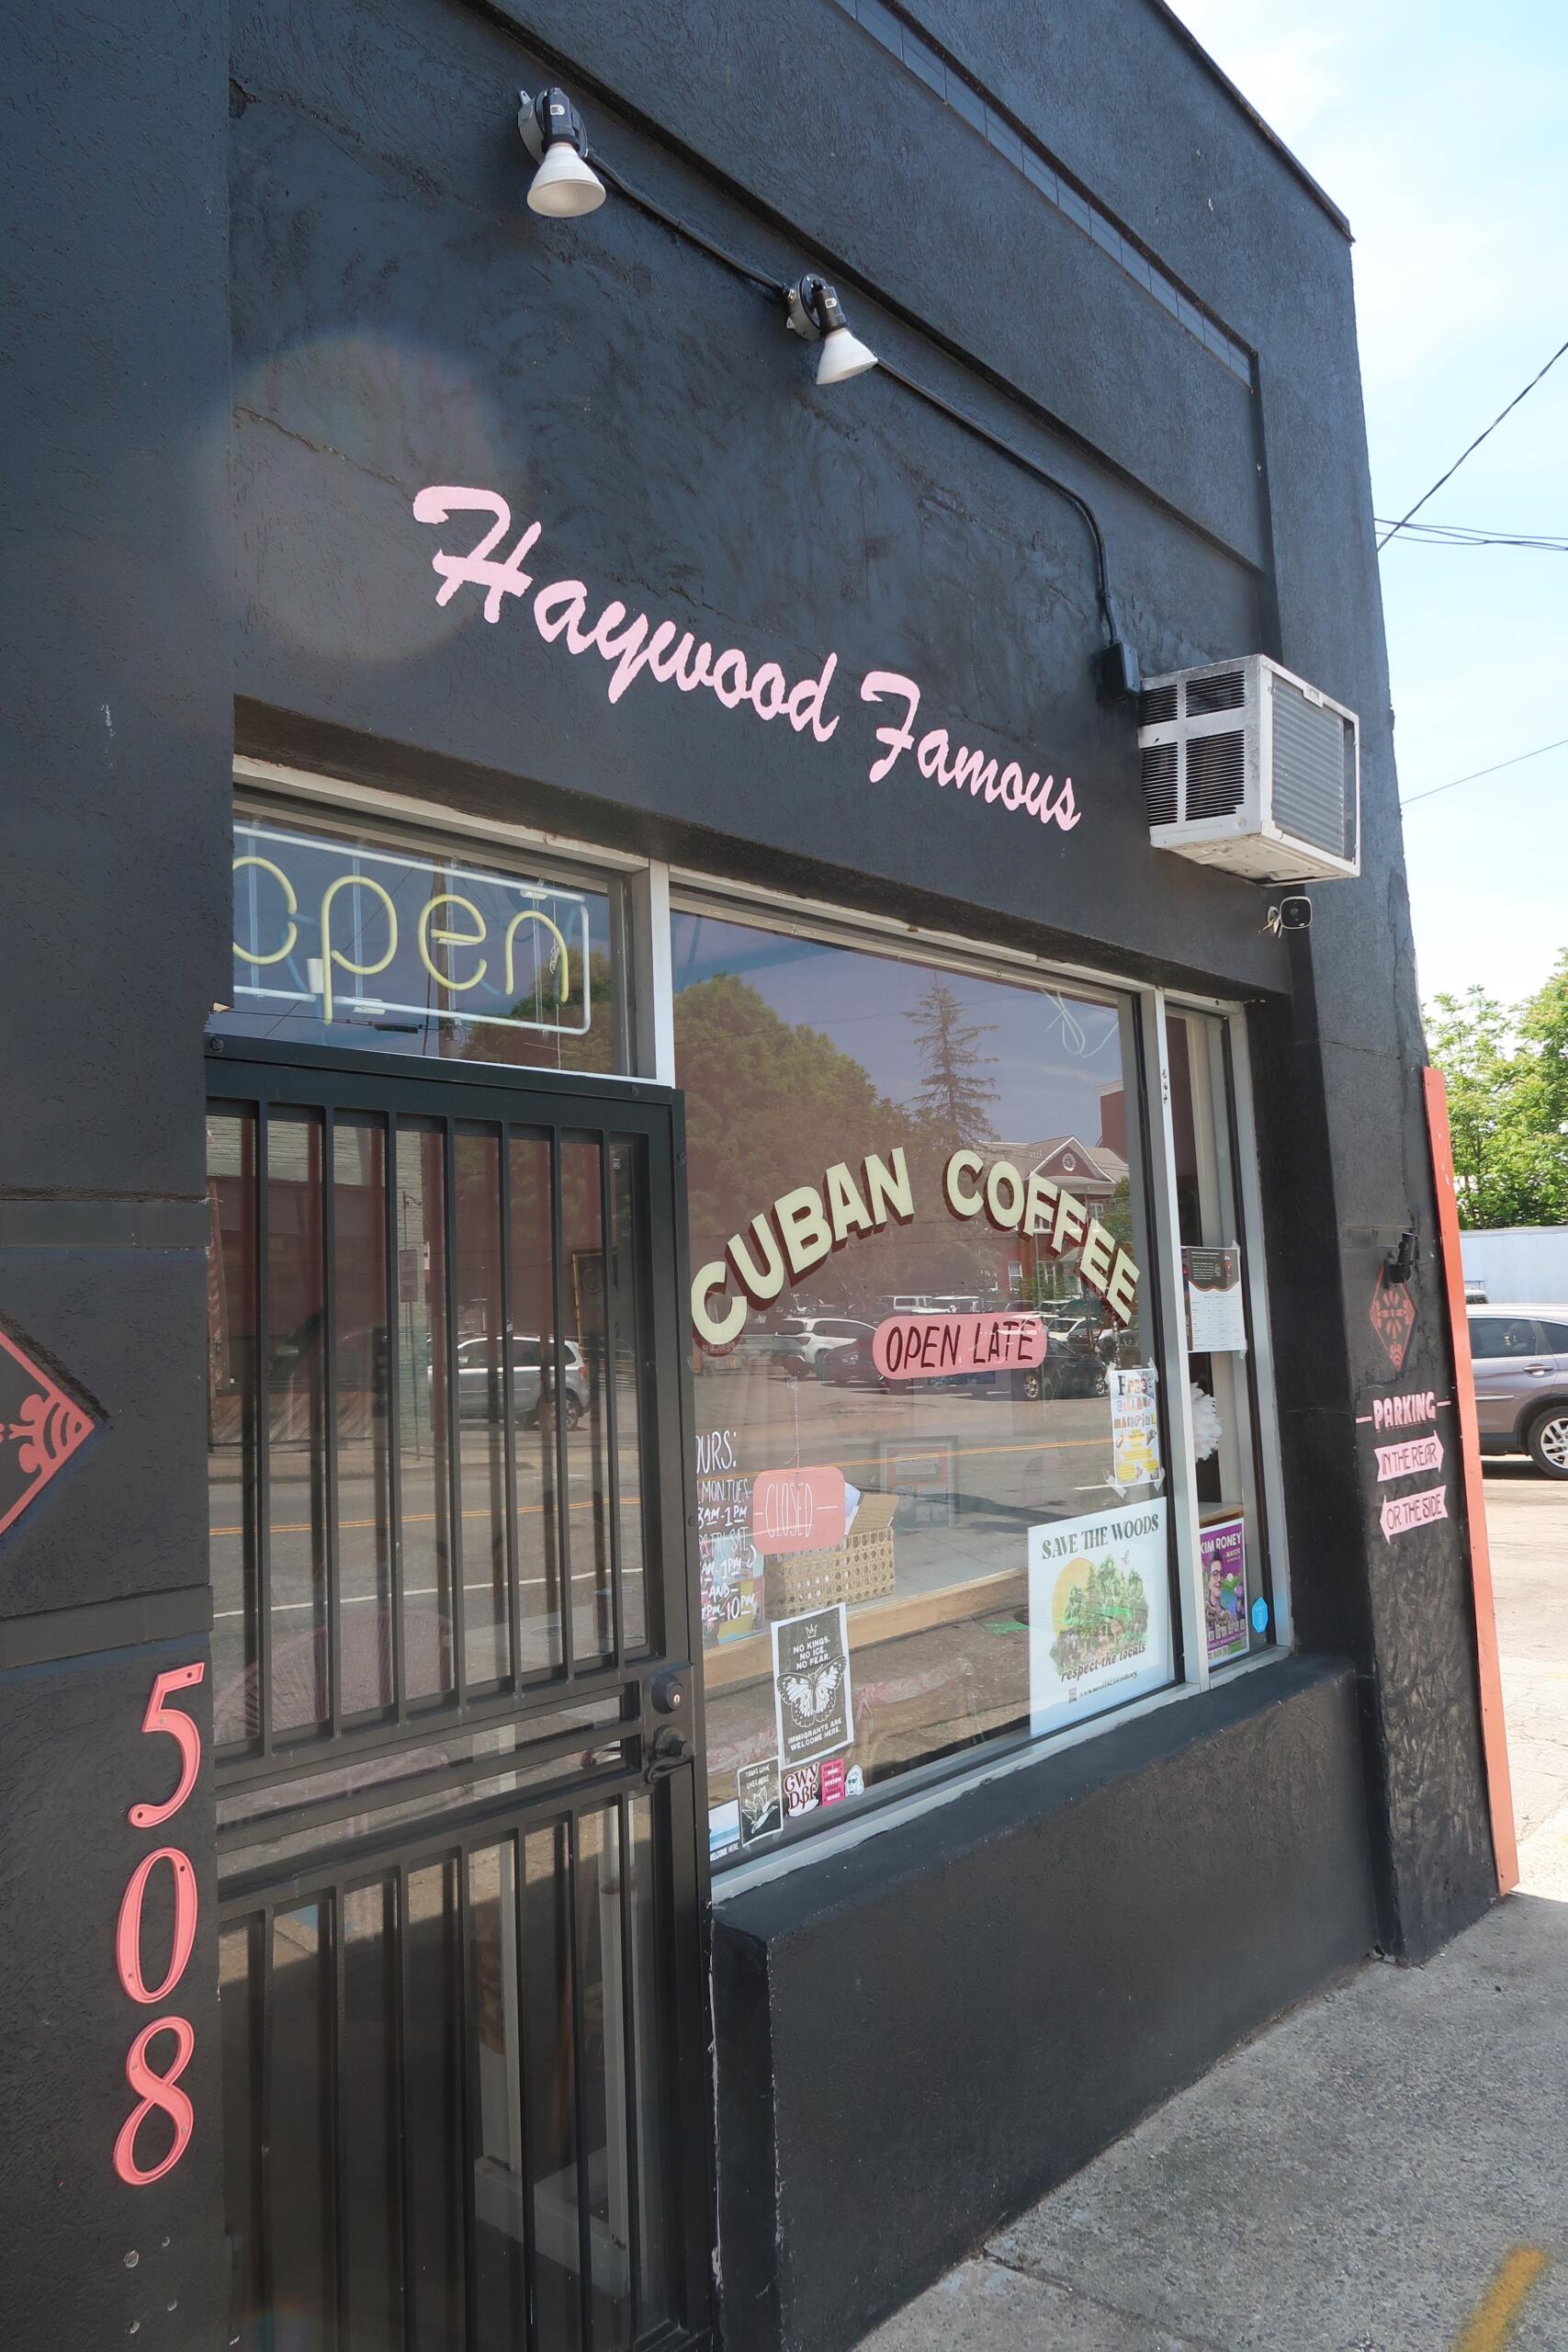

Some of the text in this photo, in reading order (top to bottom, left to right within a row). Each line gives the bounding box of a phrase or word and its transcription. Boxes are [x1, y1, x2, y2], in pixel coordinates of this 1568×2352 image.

[413, 485, 1081, 831] Haywood Famous
[691, 1147, 1140, 1347] CUBAN COFFEE
[886, 1319, 1036, 1373] OPEN LATE
[1372, 1391, 1437, 1431] PARKING
[1381, 1442, 1438, 1476] IN THE REAR
[765, 1482, 813, 1538] CLOSED
[1386, 1494, 1442, 1531] OR THE SIDE
[1042, 1513, 1159, 1560] SAVE THE WOODS
[1215, 1531, 1242, 1550] RONEY
[793, 1644, 805, 1655] NO
[795, 1661, 807, 1671] NO
[799, 1650, 810, 1661] NO
[1060, 1640, 1146, 1683] respect the locals
[787, 1717, 842, 1745] IMMIGRANTS ARE
[790, 1733, 823, 1752] WELCOME
[114, 1662, 205, 2186] 508
